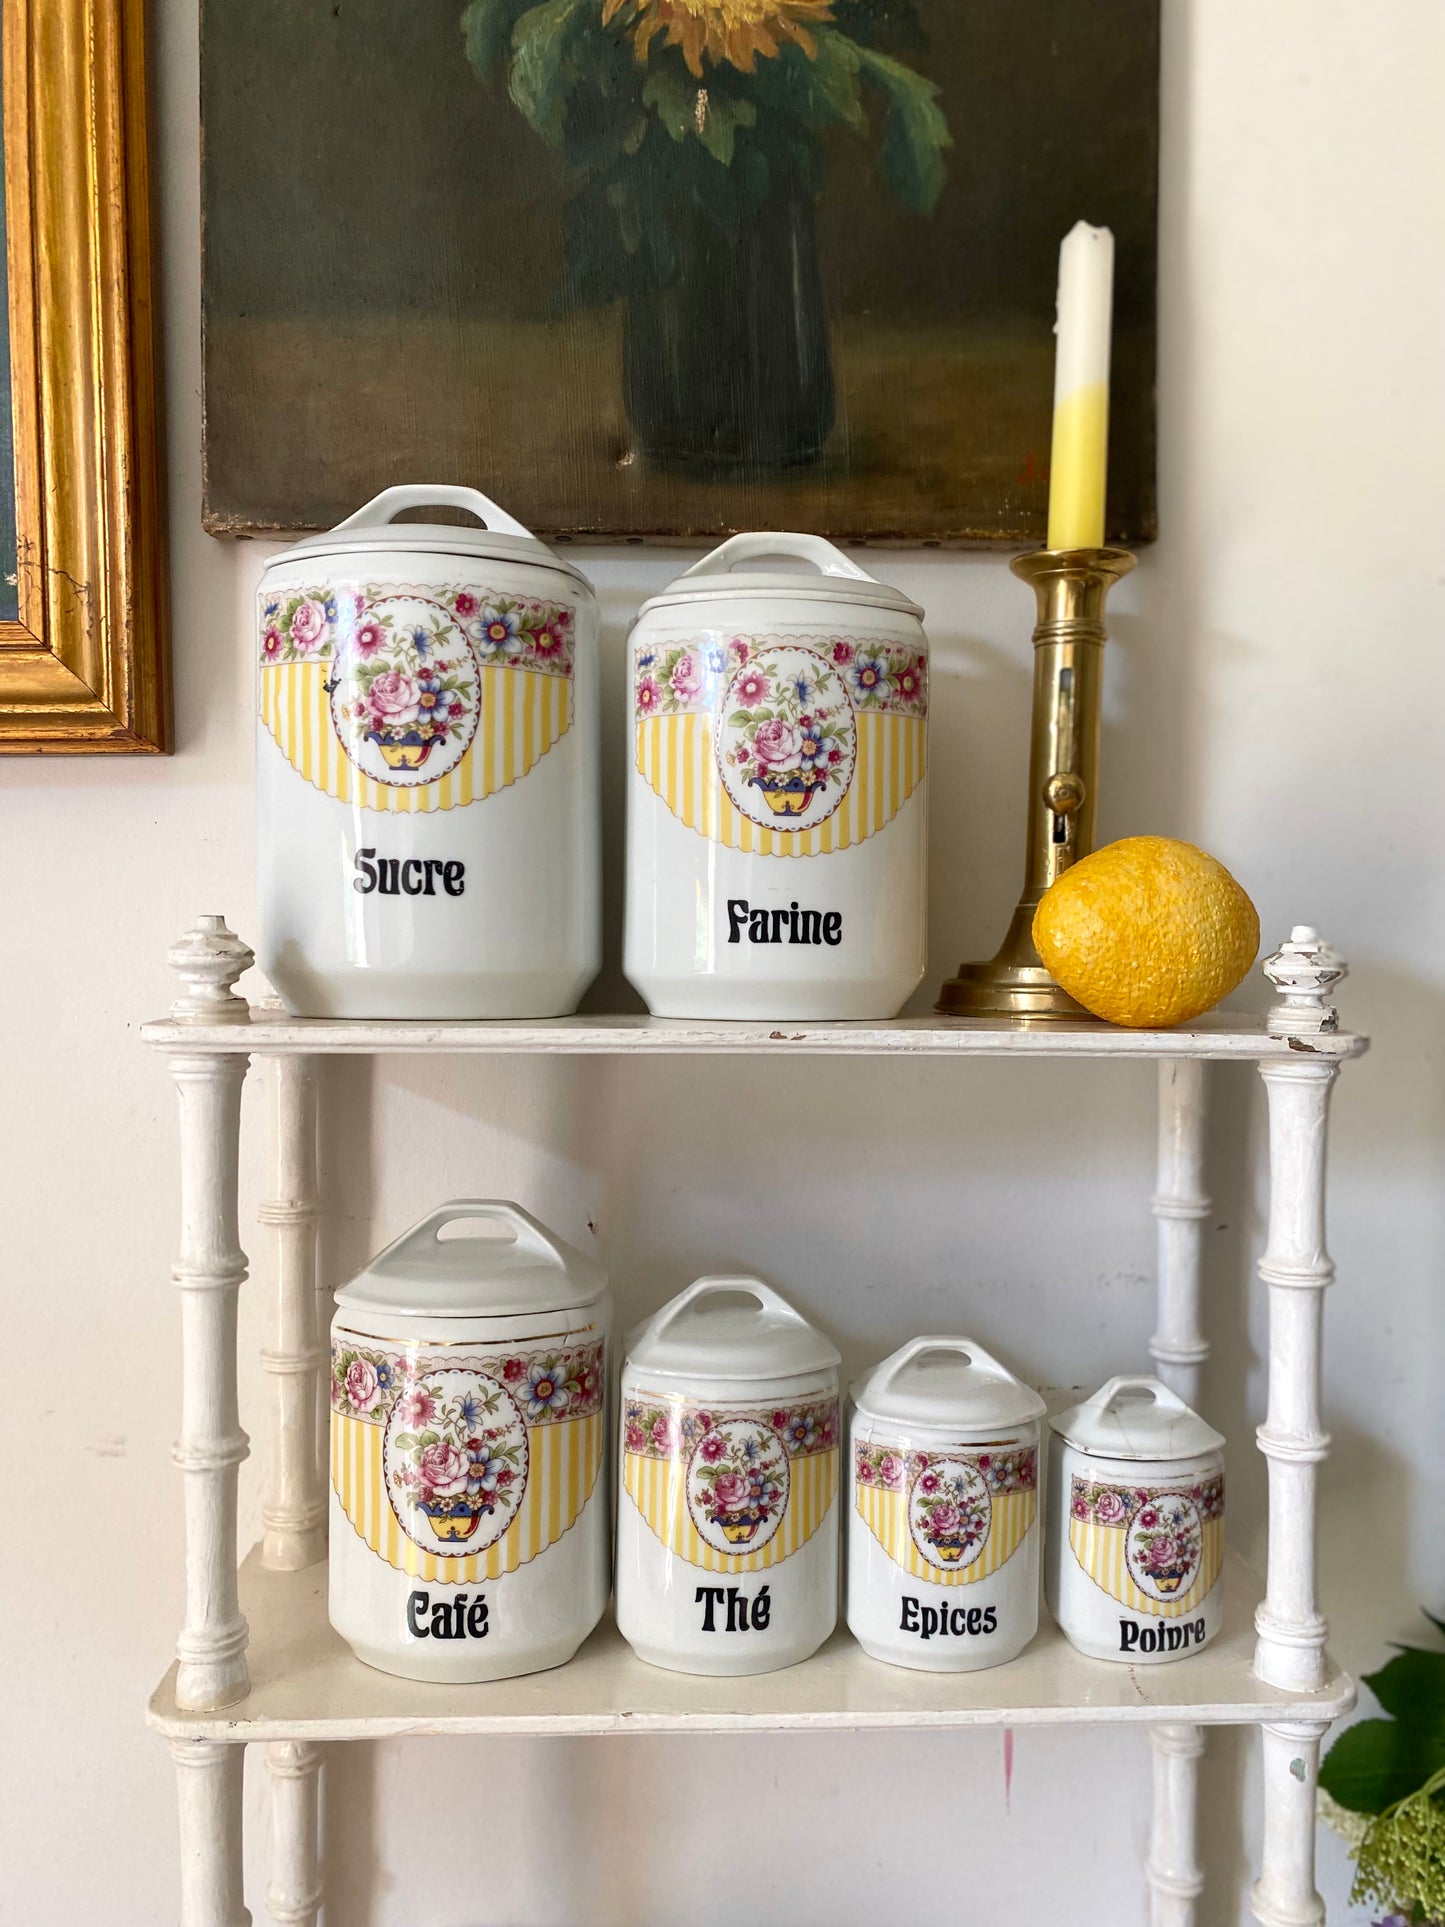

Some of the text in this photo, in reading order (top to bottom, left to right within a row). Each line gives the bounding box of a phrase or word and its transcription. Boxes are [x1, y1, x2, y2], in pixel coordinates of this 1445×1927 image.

[352, 848, 465, 896] Sucre
[727, 899, 843, 945] Farine
[408, 1589, 490, 1639] Café
[694, 1584, 771, 1632] Thé
[899, 1595, 998, 1639] Epices
[1118, 1616, 1206, 1653] Poivre
